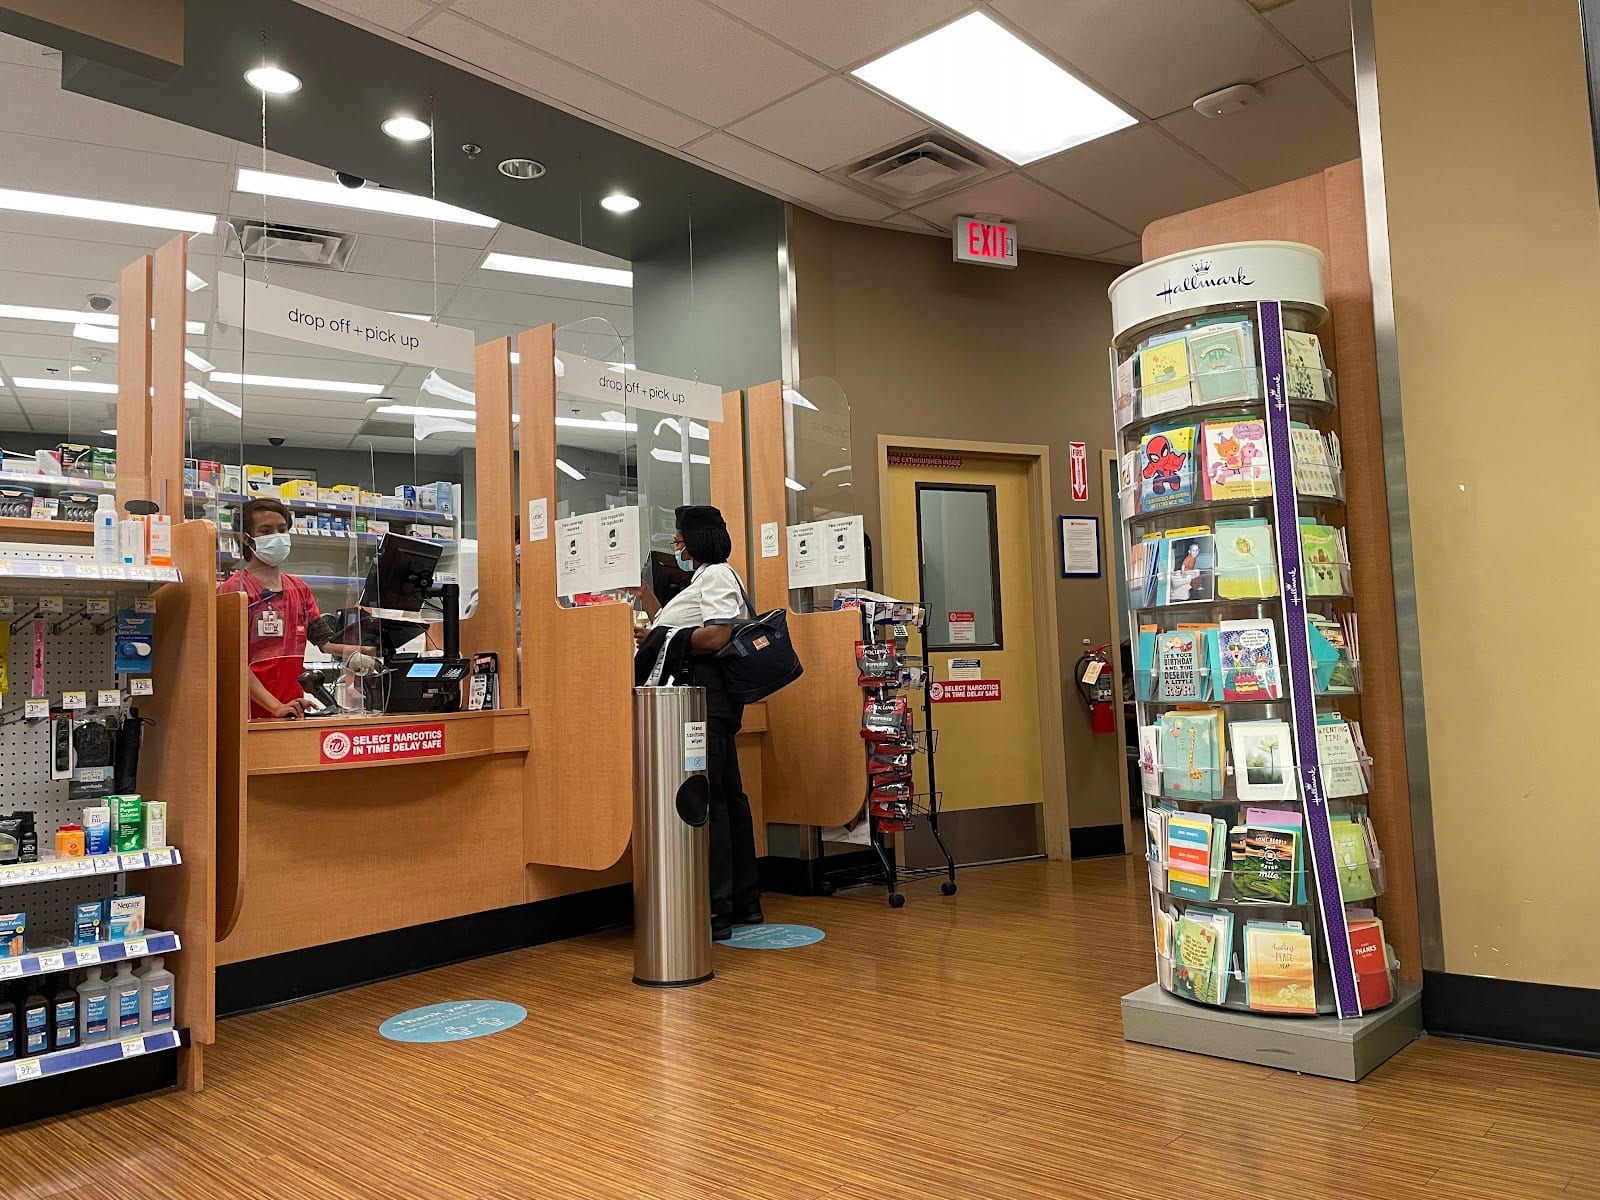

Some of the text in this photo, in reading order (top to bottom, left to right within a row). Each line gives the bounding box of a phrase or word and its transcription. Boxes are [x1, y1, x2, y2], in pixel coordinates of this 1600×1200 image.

[968, 222, 1008, 259] EXIT
[1156, 267, 1255, 304] Hallmark
[288, 308, 325, 330] drop
[330, 318, 350, 334] off
[366, 326, 396, 344] pick
[401, 335, 419, 350] up
[599, 376, 622, 391] drop
[626, 382, 640, 394] off
[649, 387, 670, 400] pick
[672, 393, 685, 405] up
[1273, 373, 1285, 412] Hallmark
[901, 456, 942, 465] EXTINGUISHER
[1291, 567, 1301, 606] Hallmark
[1165, 671, 1194, 680] DESERVE
[353, 730, 442, 745] SELECT NARCOTICS
[353, 739, 442, 755] IN TIME DELAY SAFE
[1311, 767, 1321, 806] Hallmark
[1355, 945, 1376, 955] THANKS
[393, 1012, 444, 1026] Thank
